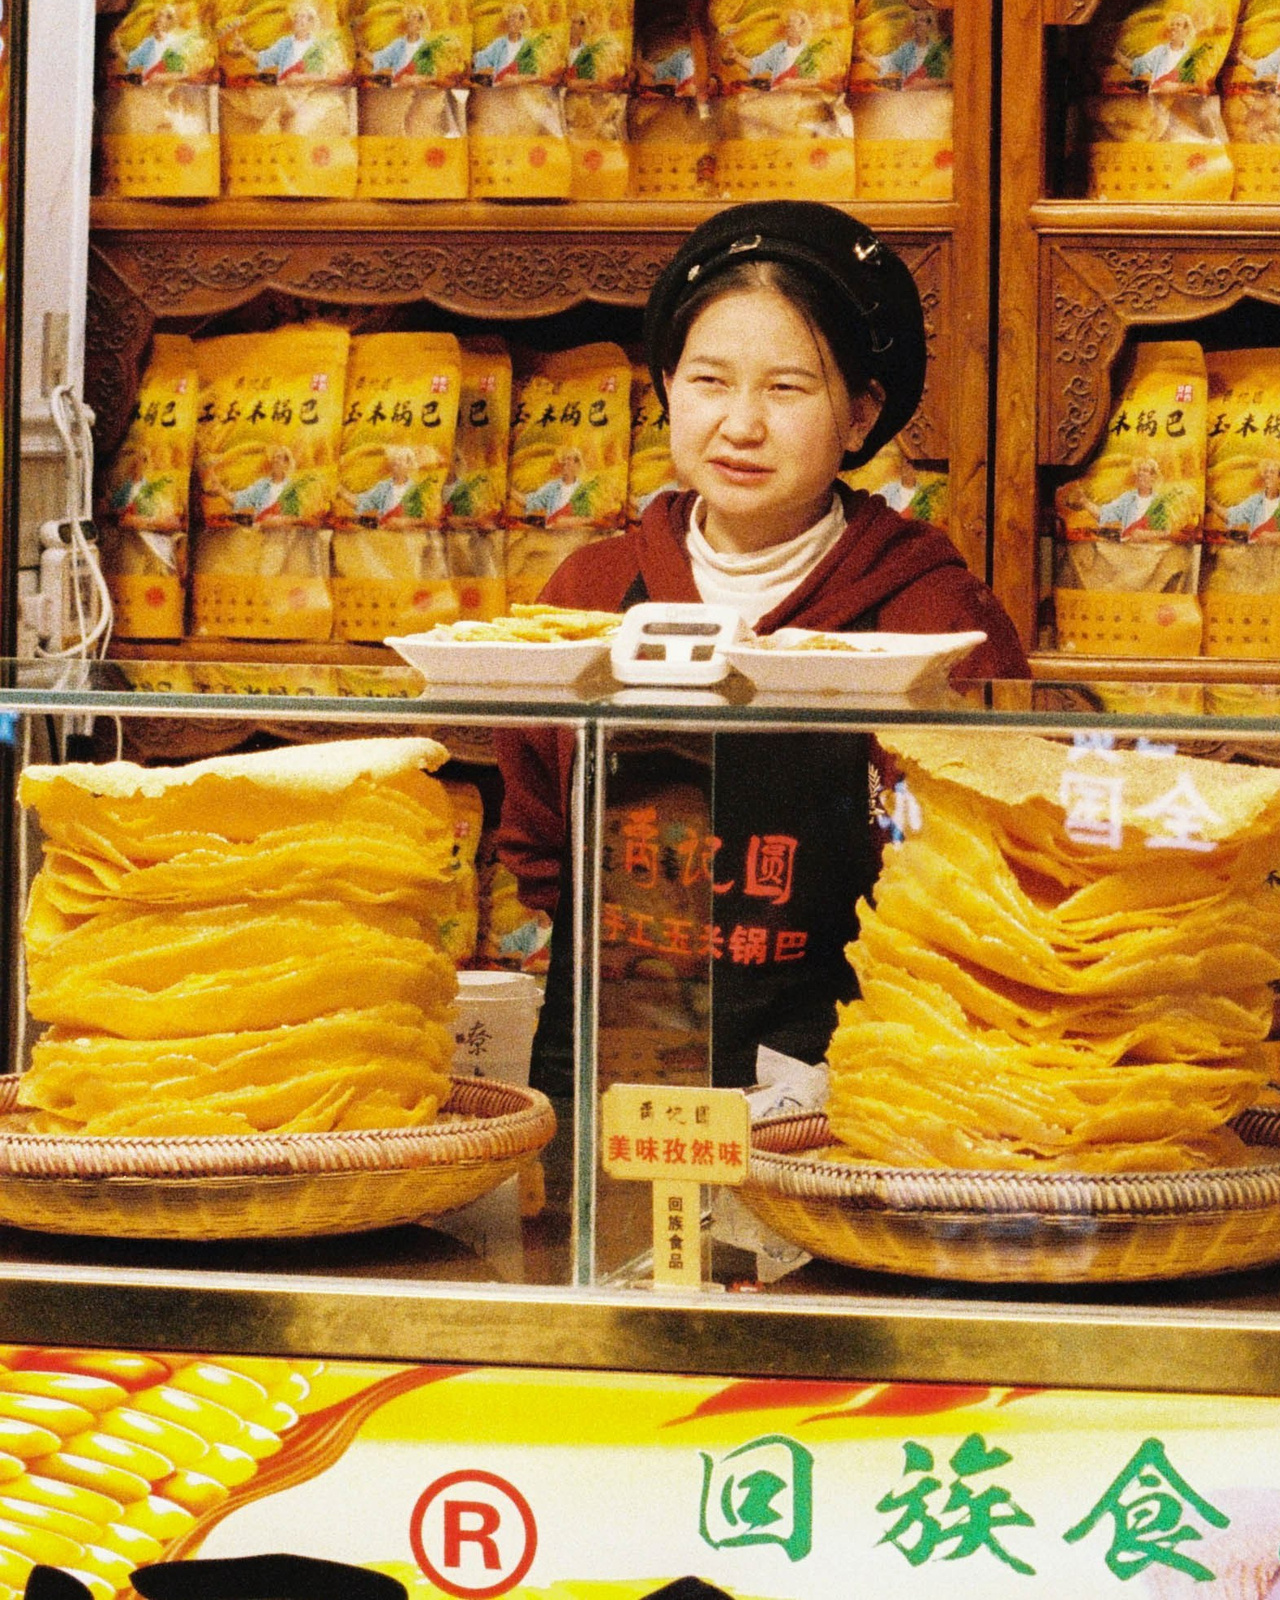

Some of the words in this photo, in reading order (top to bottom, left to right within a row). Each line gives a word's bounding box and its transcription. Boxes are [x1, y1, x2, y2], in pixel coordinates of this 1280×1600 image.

[609, 1135, 743, 1167] 美味孜然味
[668, 1197, 684, 1270] 回族食品
